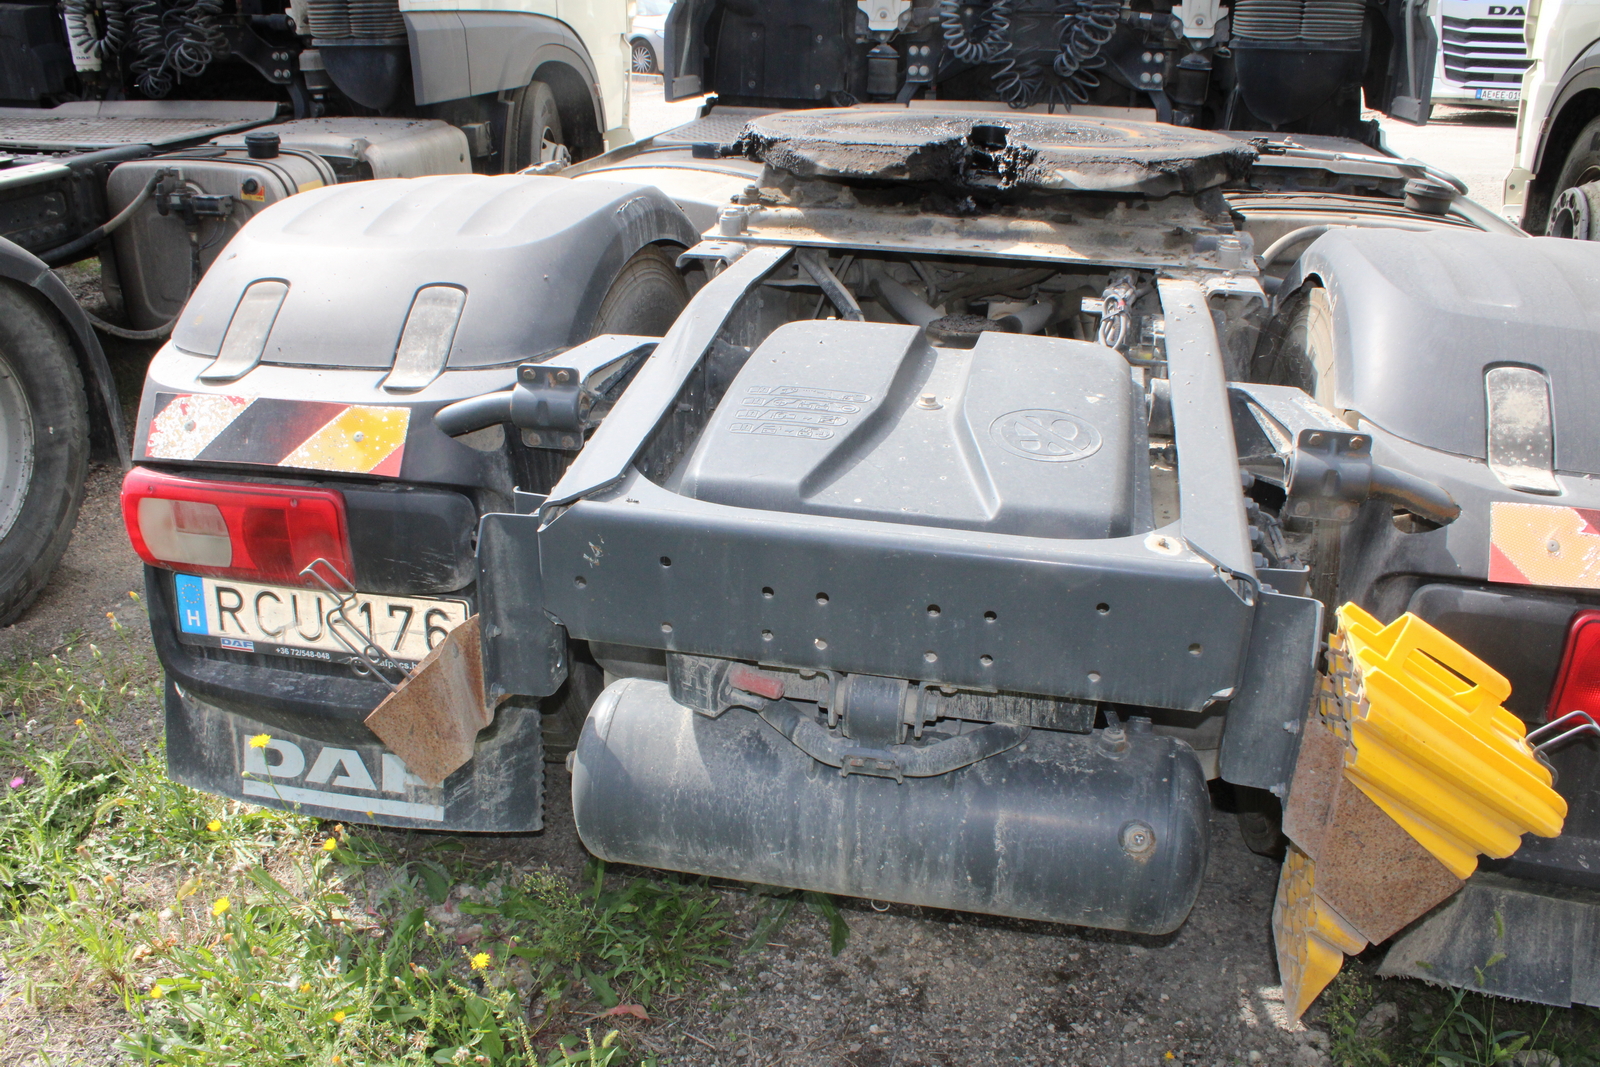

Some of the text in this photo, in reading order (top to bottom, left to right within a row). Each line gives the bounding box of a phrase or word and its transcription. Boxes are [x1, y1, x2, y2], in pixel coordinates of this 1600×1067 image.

[187, 608, 201, 627] H
[221, 638, 253, 648] DAF
[276, 647, 290, 655] +36
